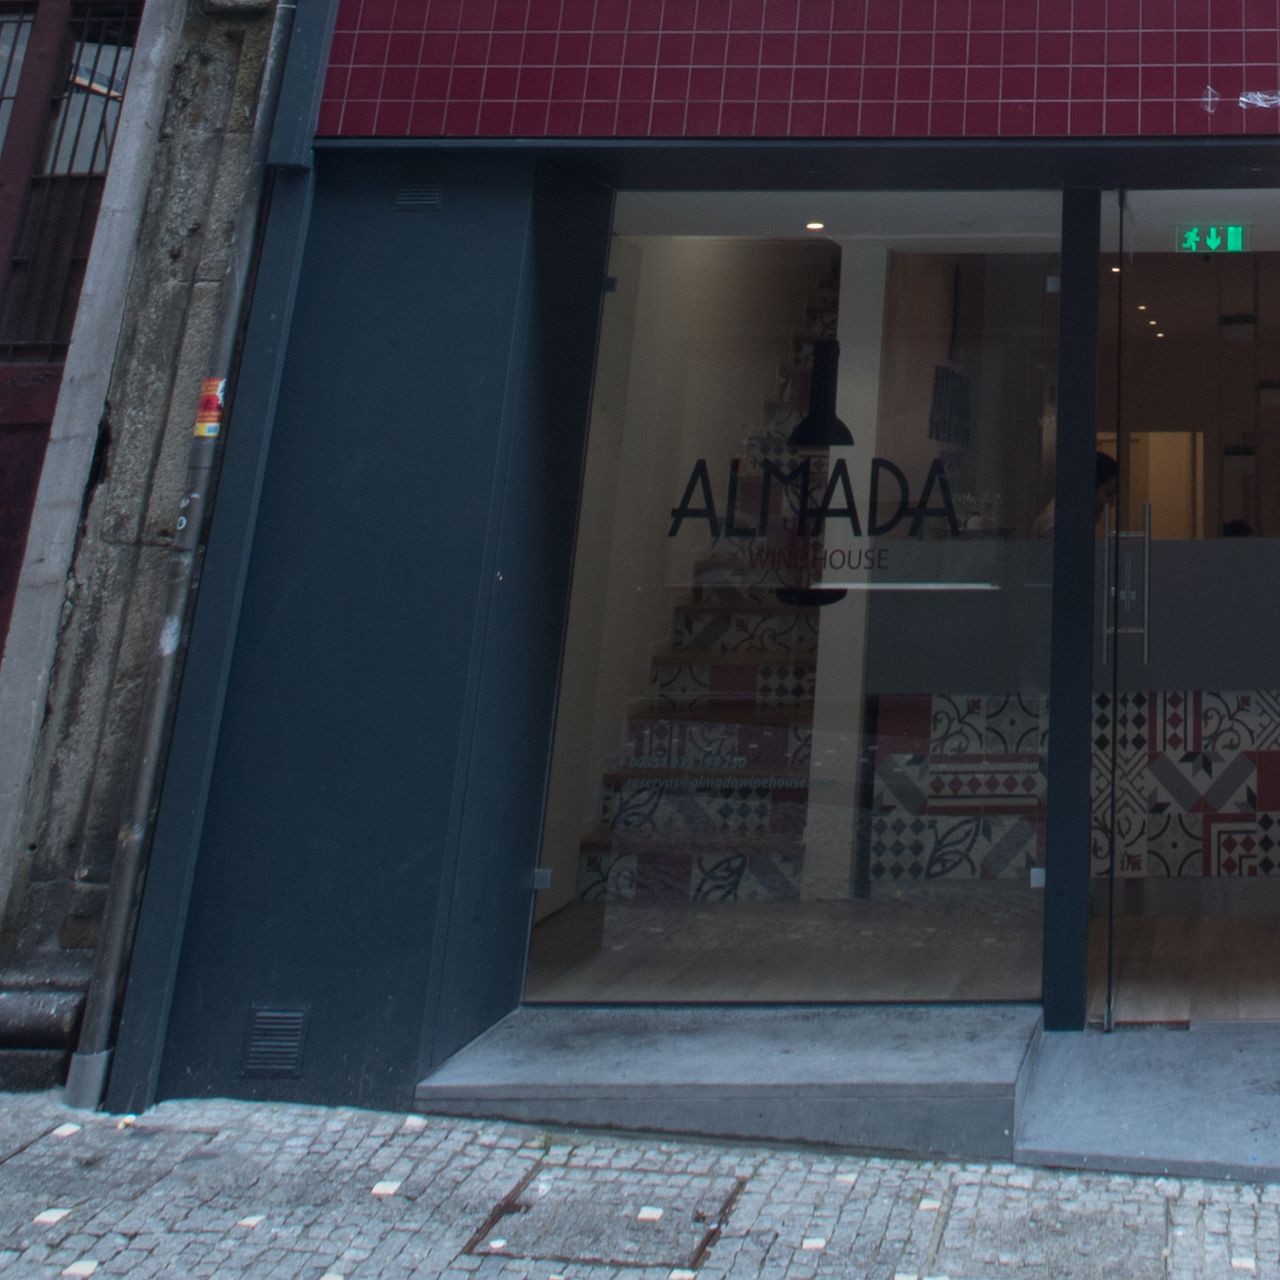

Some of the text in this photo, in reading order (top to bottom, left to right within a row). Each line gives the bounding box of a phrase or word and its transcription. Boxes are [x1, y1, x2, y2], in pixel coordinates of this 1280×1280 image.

[668, 458, 960, 537] ALMADA
[750, 549, 889, 571] WINE HOUSE
